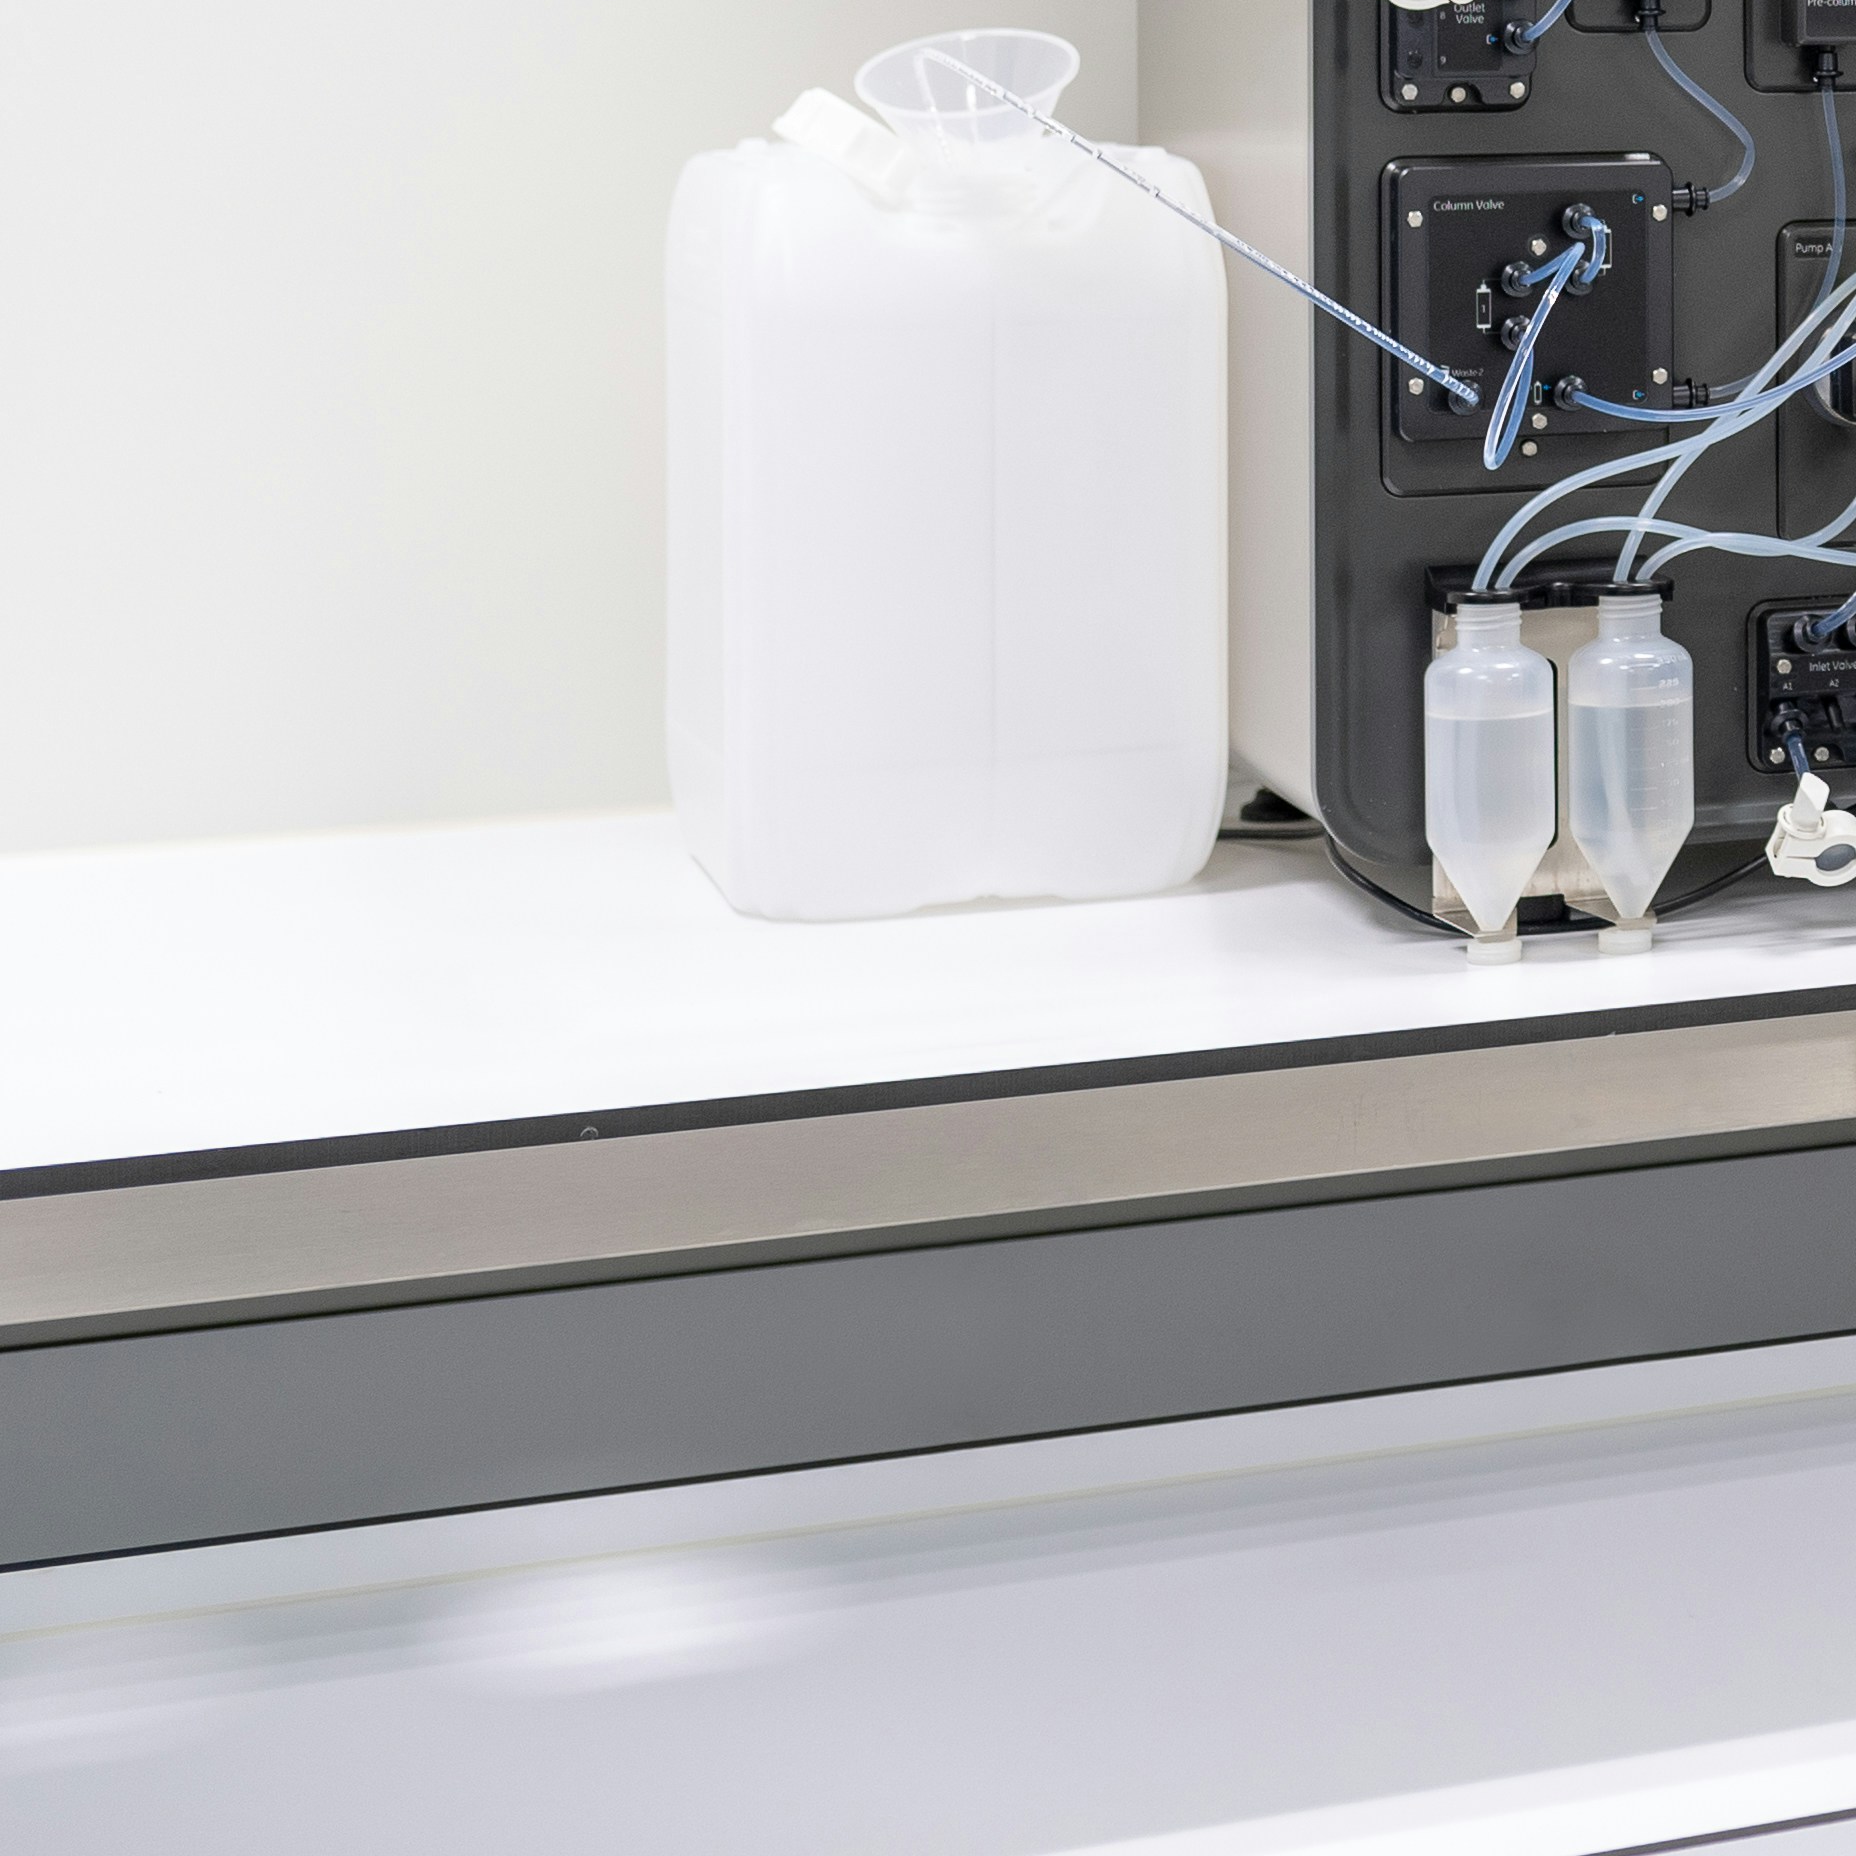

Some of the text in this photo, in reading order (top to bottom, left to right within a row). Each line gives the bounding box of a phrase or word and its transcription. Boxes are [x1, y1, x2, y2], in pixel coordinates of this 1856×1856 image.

[1453, 2, 1486, 14] Outlet
[1455, 13, 1485, 25] Valve
[1440, 56, 1446, 65] 9
[1433, 199, 1505, 212] Column Valve
[1795, 242, 1833, 255] Pump A
[1808, 661, 1831, 672] Inlet
[1782, 681, 1793, 691] A1
[1829, 678, 1840, 688] A2
